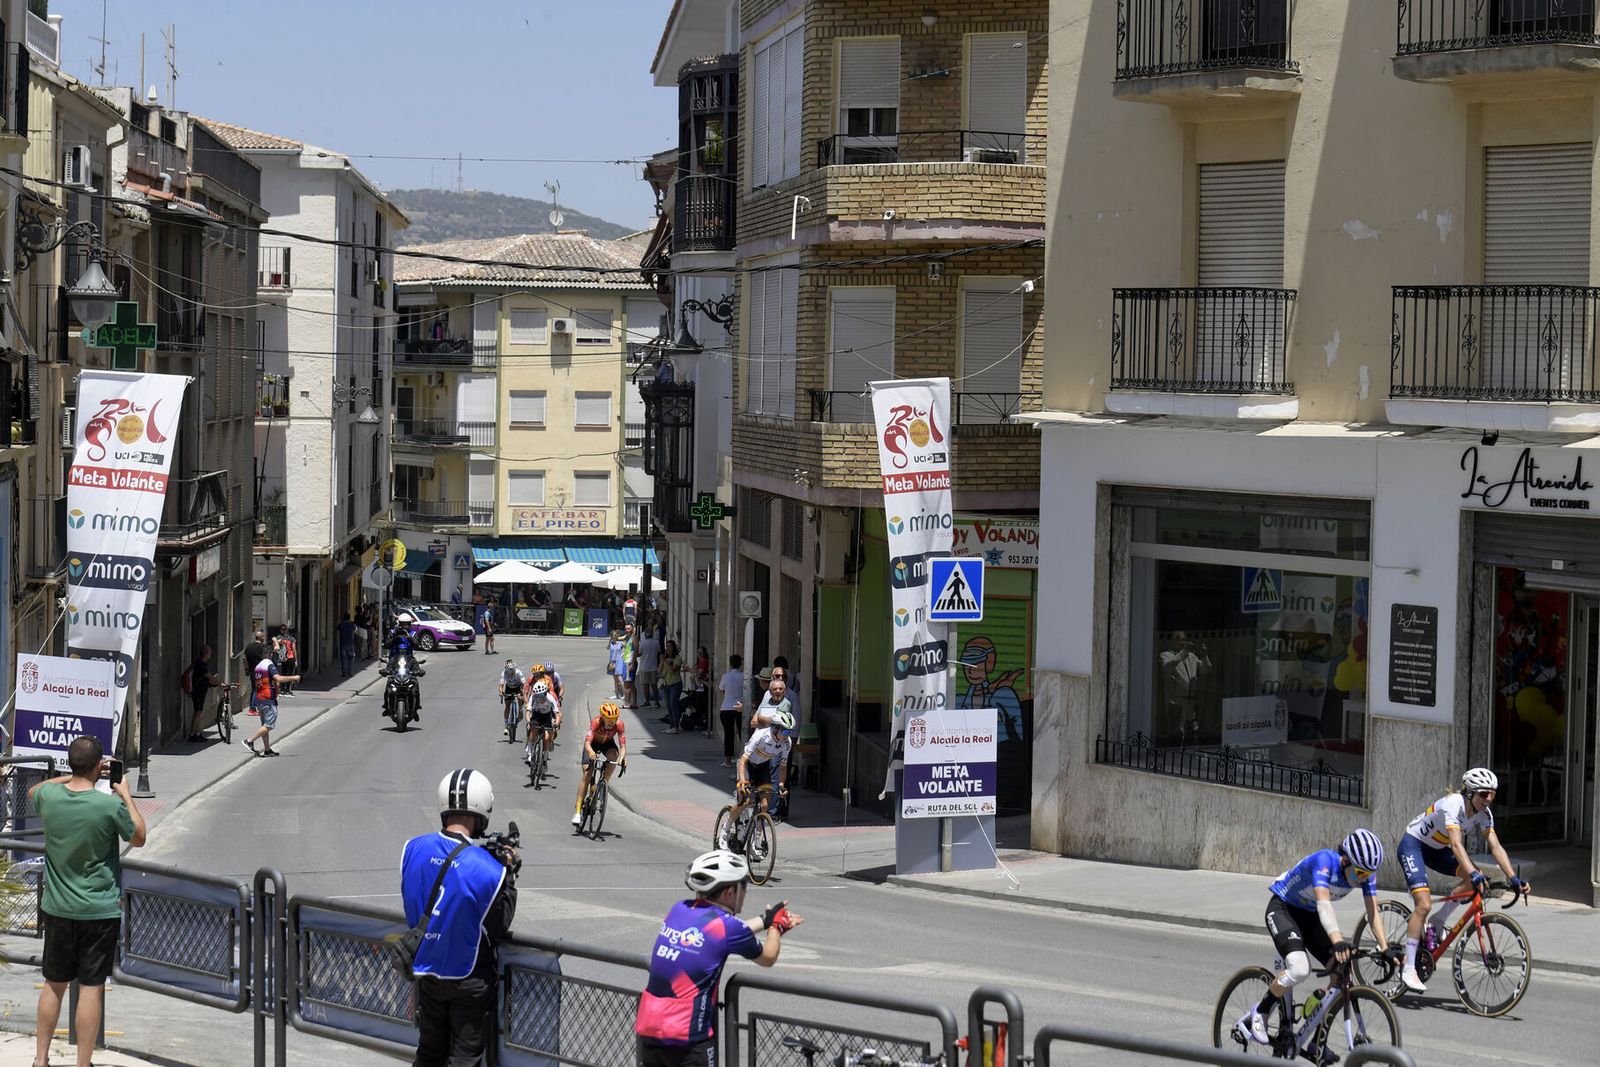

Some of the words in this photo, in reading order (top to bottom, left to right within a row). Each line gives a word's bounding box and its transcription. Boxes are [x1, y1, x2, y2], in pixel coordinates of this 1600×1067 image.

[115, 451, 130, 460] UCI
[914, 455, 927, 463] UCI
[71, 467, 107, 486] Meta
[111, 471, 164, 492] Volante
[885, 475, 914, 492] Meta
[915, 473, 951, 489] Volante
[1460, 446, 1490, 498] La
[1482, 447, 1594, 508] Atrevida
[92, 507, 158, 535] mimo
[518, 520, 541, 528] EL
[545, 520, 601, 529] PIREO
[909, 508, 952, 533] mimo
[1008, 555, 1020, 564] 953
[1021, 556, 1034, 564] 587
[87, 556, 146, 582] mimo
[85, 604, 140, 631] mimo
[42, 683, 75, 695] Alcalá
[76, 686, 85, 696] la
[87, 687, 110, 698] Real
[43, 715, 83, 732] META
[930, 735, 960, 745] Alcalá
[962, 735, 971, 744] la
[973, 734, 992, 743] Real
[931, 765, 970, 779] META
[918, 779, 983, 794] VOLANTE
[928, 804, 948, 812] RUTA
[964, 803, 978, 811] SOL
[656, 944, 680, 961] BH
